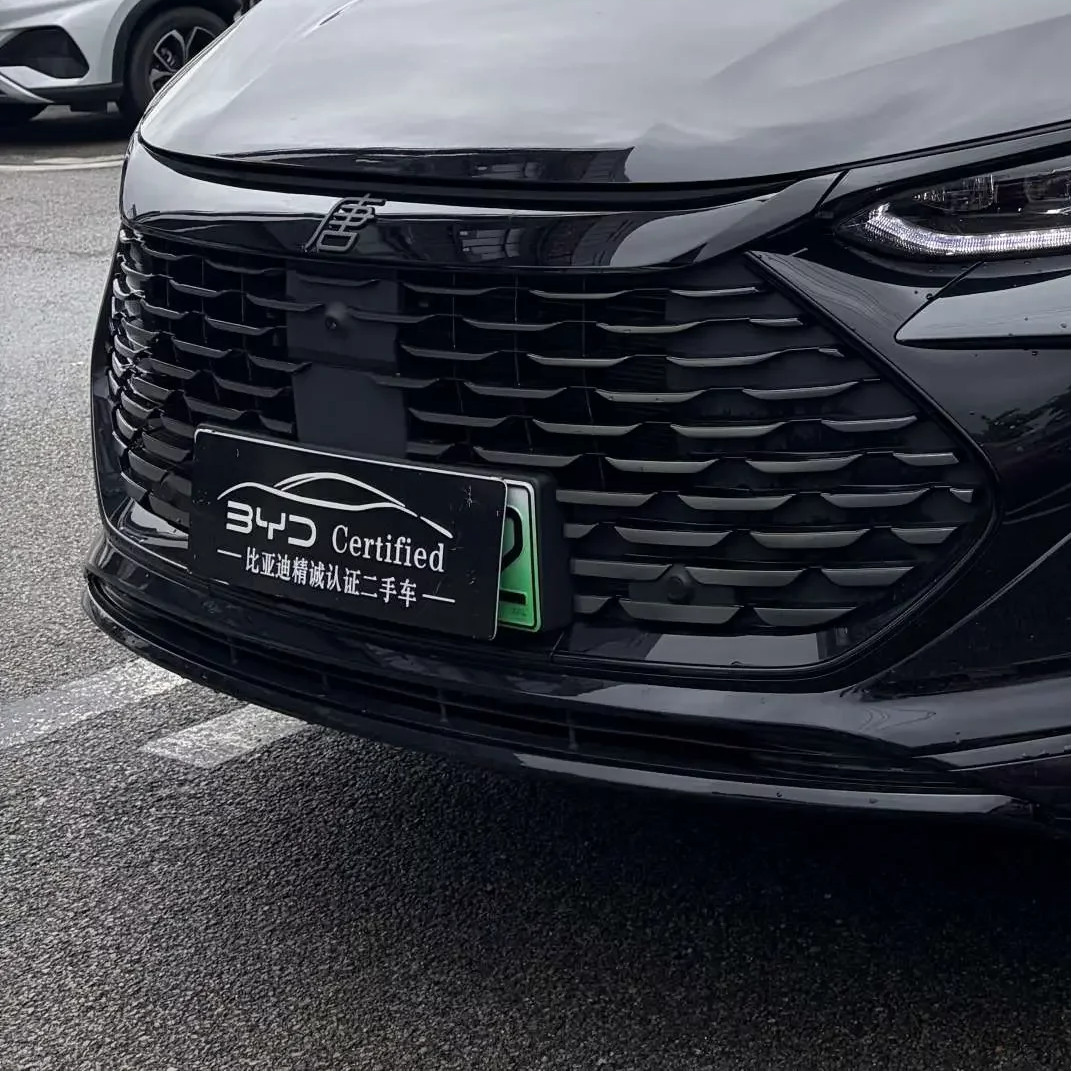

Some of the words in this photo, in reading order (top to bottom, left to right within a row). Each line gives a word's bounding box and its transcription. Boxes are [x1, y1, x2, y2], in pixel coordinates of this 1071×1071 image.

[226, 500, 316, 547] BYD
[332, 525, 444, 572] Certified
[245, 548, 417, 608] 比亚迪精诚认证二手车
